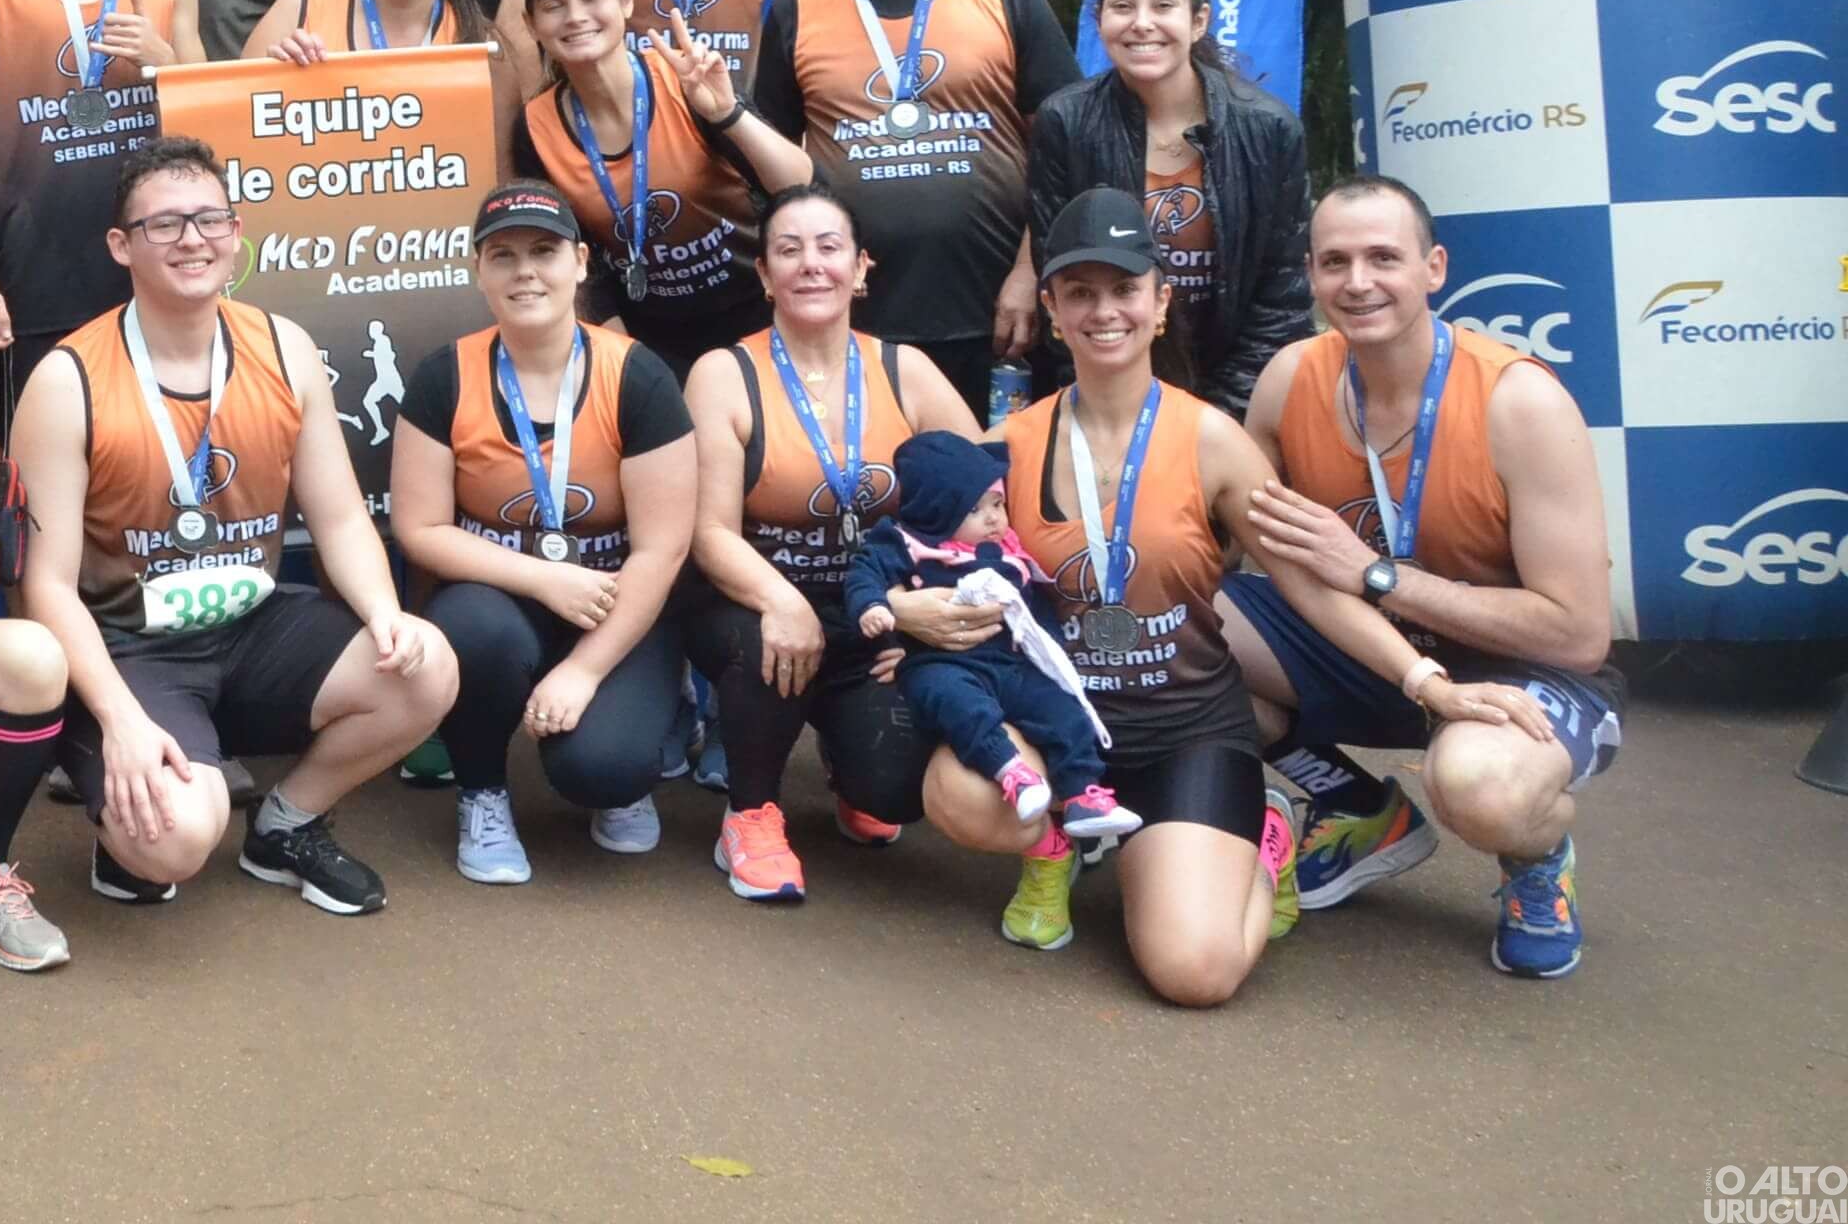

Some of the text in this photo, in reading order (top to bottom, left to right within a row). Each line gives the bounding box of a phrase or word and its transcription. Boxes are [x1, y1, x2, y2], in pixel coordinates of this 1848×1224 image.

[251, 87, 422, 146] Equipe
[833, 110, 992, 141] Med orma
[1391, 102, 1587, 144] Fecomércio RS
[53, 139, 116, 164] SEBERI
[848, 135, 981, 160] Academia
[285, 145, 469, 200] corrida
[860, 160, 971, 180] SEBERI RS
[346, 224, 471, 267] FORMA
[653, 216, 736, 265] Forma
[326, 265, 470, 296] Academia
[1660, 315, 1836, 346] Fecomércio
[1141, 669, 1169, 686] RS
